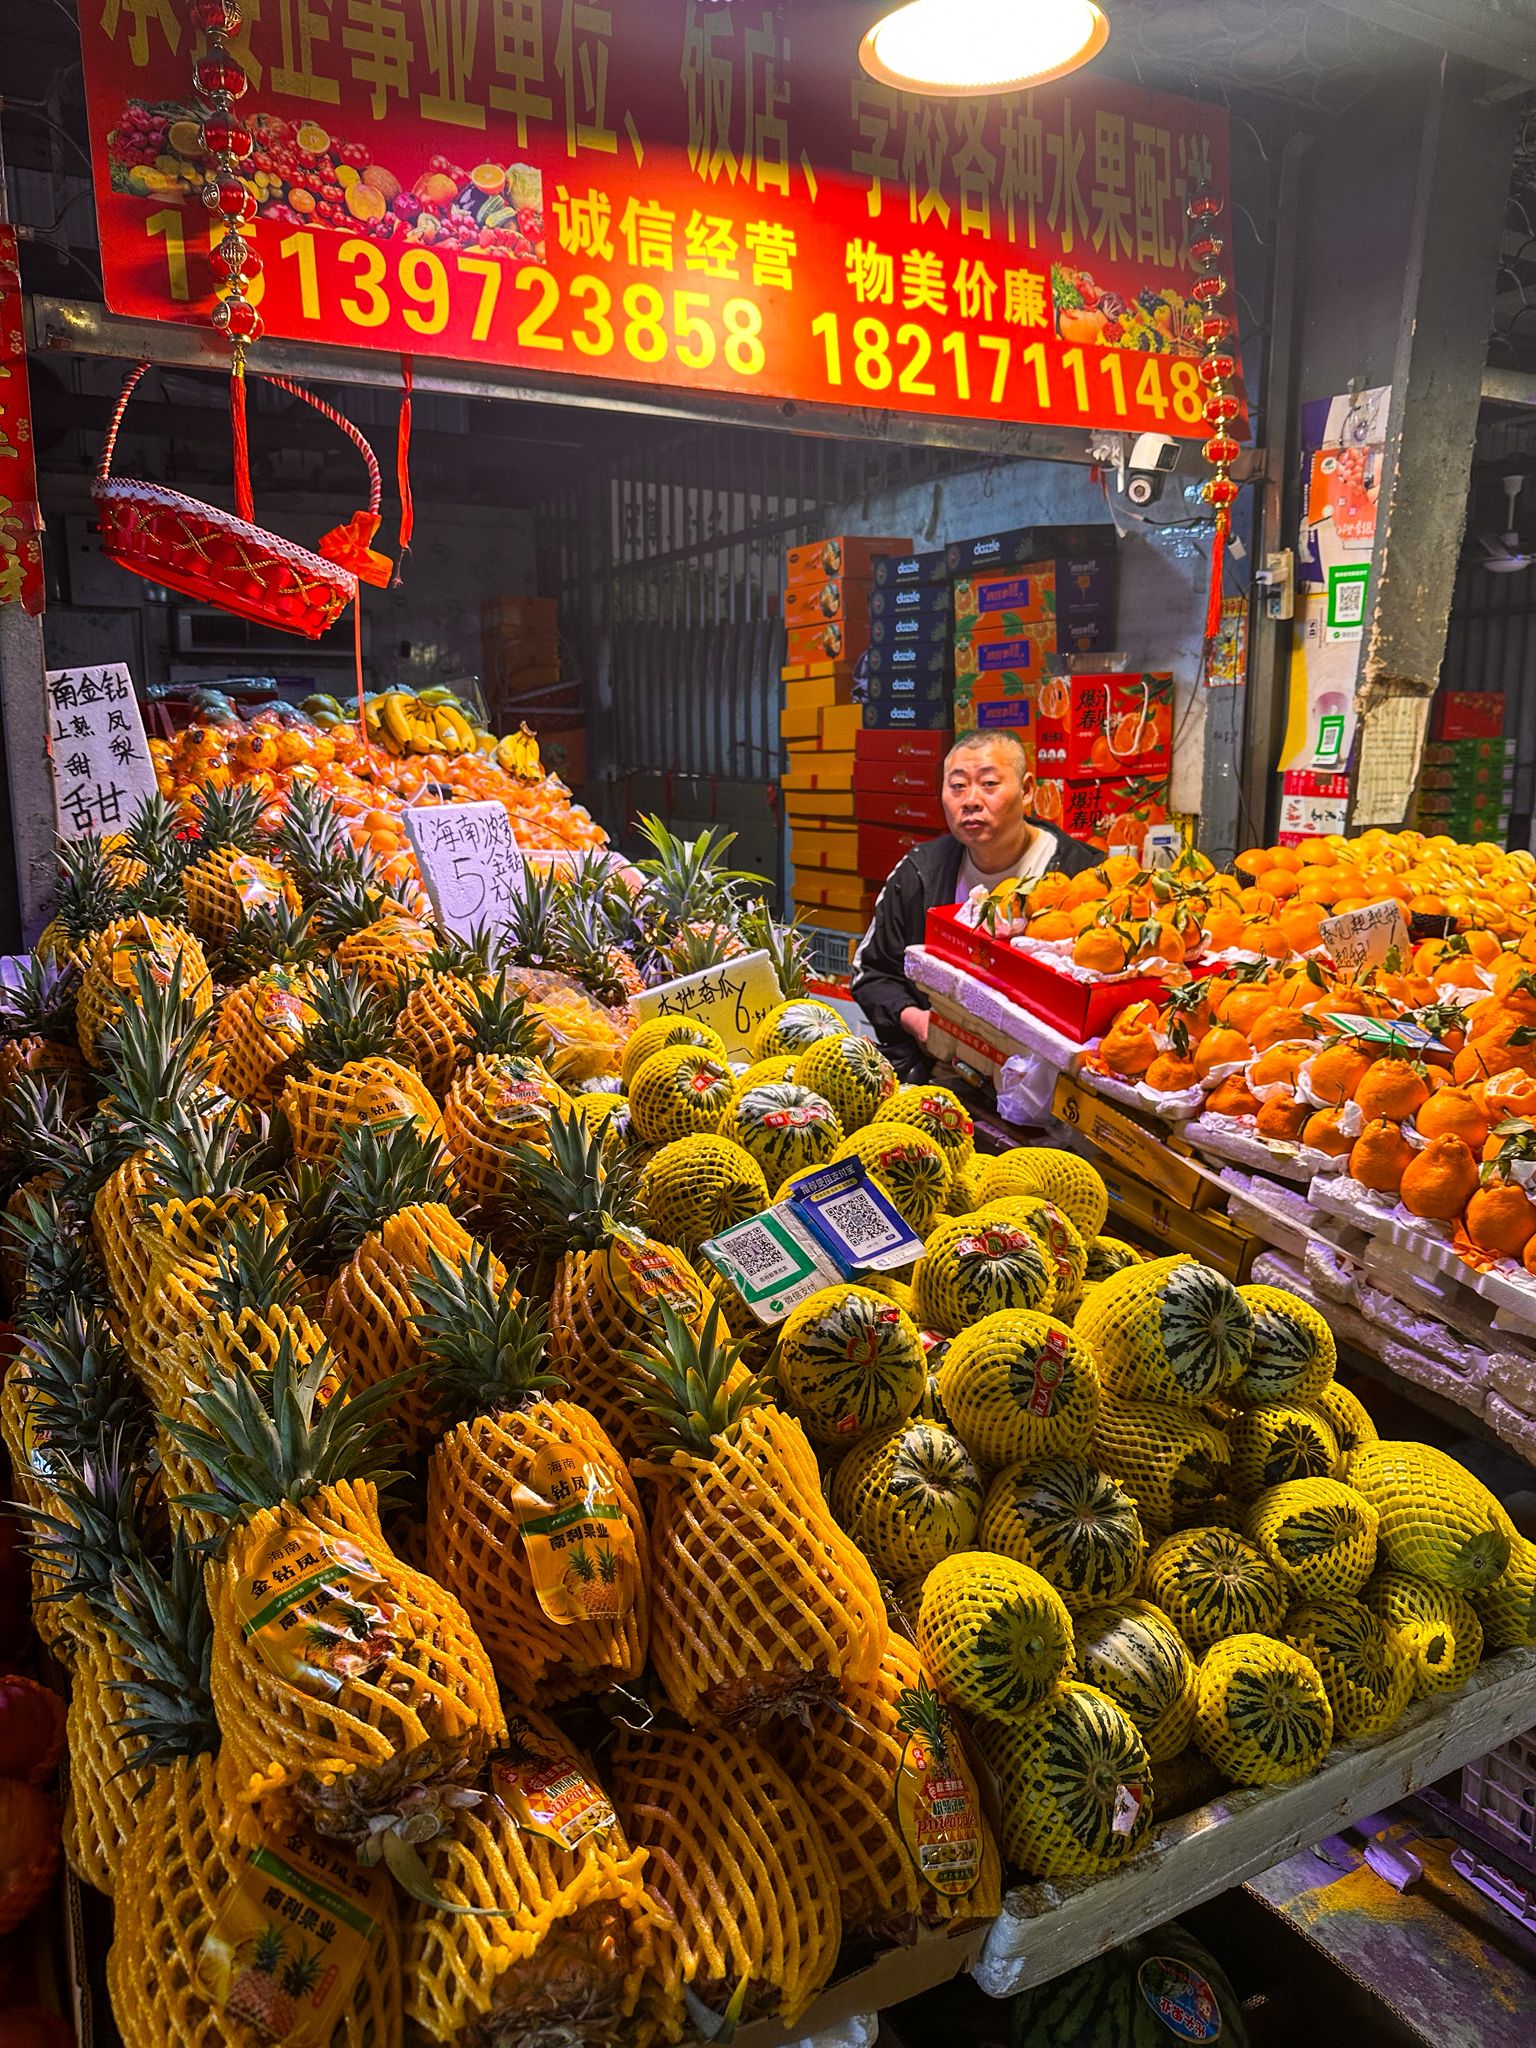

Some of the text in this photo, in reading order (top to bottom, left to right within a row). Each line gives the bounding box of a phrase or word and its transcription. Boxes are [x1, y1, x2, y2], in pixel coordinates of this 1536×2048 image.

[552, 185, 1048, 328] 诚信经营 物美价廉
[812, 312, 1208, 423] 1821711148
[974, 540, 1000, 556] dazzle
[898, 561, 920, 574] dazzle
[108, 709, 145, 766] 凤梨
[447, 857, 486, 919] 5
[357, 1100, 406, 1121] 金钻凤
[799, 1164, 857, 1195] 推荐使用支付宝
[783, 1282, 818, 1306] 微信支付
[546, 1457, 576, 1476] 海南
[266, 1539, 301, 1564] 海南
[548, 1522, 610, 1552] 南利果业
[916, 1814, 976, 1845] pineapple
[262, 1885, 337, 1945] 南利果业
